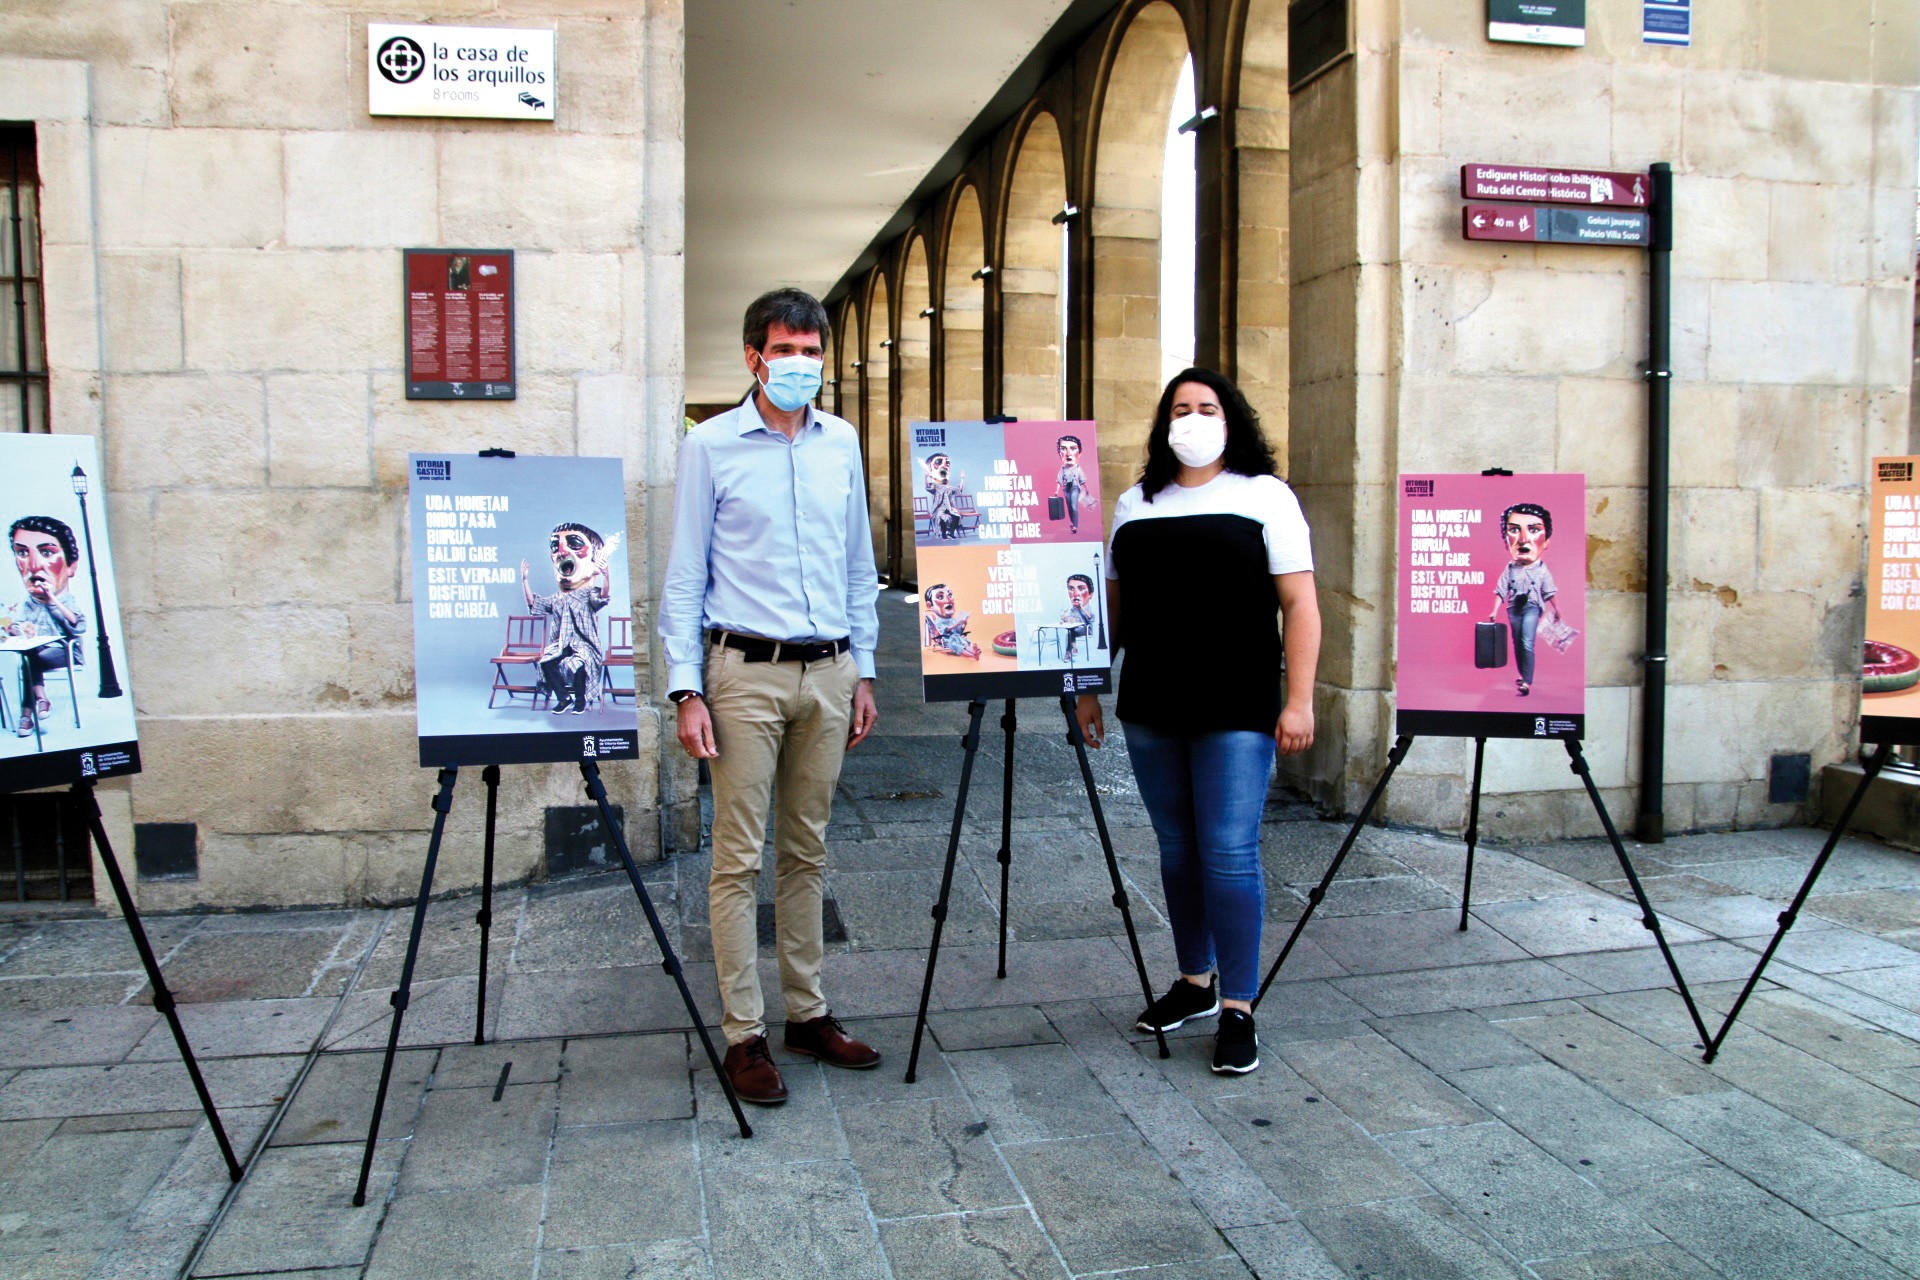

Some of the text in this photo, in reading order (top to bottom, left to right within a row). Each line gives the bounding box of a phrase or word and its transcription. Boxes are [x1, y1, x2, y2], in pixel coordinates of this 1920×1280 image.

[433, 42, 528, 62] la casa de
[433, 63, 546, 87] los arquillos
[433, 88, 480, 101] 8 rooms
[1476, 168, 1518, 182] Erdigune
[1571, 173, 1611, 184] ibilbid
[1477, 184, 1588, 199] Ruta del Centro Histórico
[1494, 218, 1504, 228] 40
[1587, 216, 1640, 228] Goiuri jauregia
[1579, 228, 1640, 240] Palacio Villa Suso
[994, 460, 1018, 474] UDA
[984, 476, 1032, 490] HONETAN
[425, 495, 508, 512] UDA HONETAN
[976, 491, 1039, 506] ONDO PASA
[1886, 496, 1911, 510] UDA
[426, 512, 496, 528] ONDO PASA
[988, 507, 1029, 522] BURUA
[1412, 510, 1482, 523] UDA HONETAN
[427, 530, 473, 544] BURUA
[979, 522, 1042, 539] GALDU GABE
[1412, 524, 1470, 537] ONDO PASA
[1884, 528, 1920, 542] BURU
[1412, 538, 1450, 552] BURUA
[428, 546, 498, 562] GALDU GABE
[1411, 553, 1470, 566] GALDU GABE
[428, 568, 516, 583] ESTE VERANO
[1411, 571, 1484, 584] ESTE VERANO
[1884, 564, 1911, 578] ESTE
[428, 585, 486, 600] DISFRUTA
[1411, 586, 1458, 598] DISFRUTA
[429, 602, 498, 618] CON CABEZA
[982, 599, 1002, 614] CON
[1410, 600, 1468, 614] CON CABEZA
[1882, 596, 1904, 610] CON
